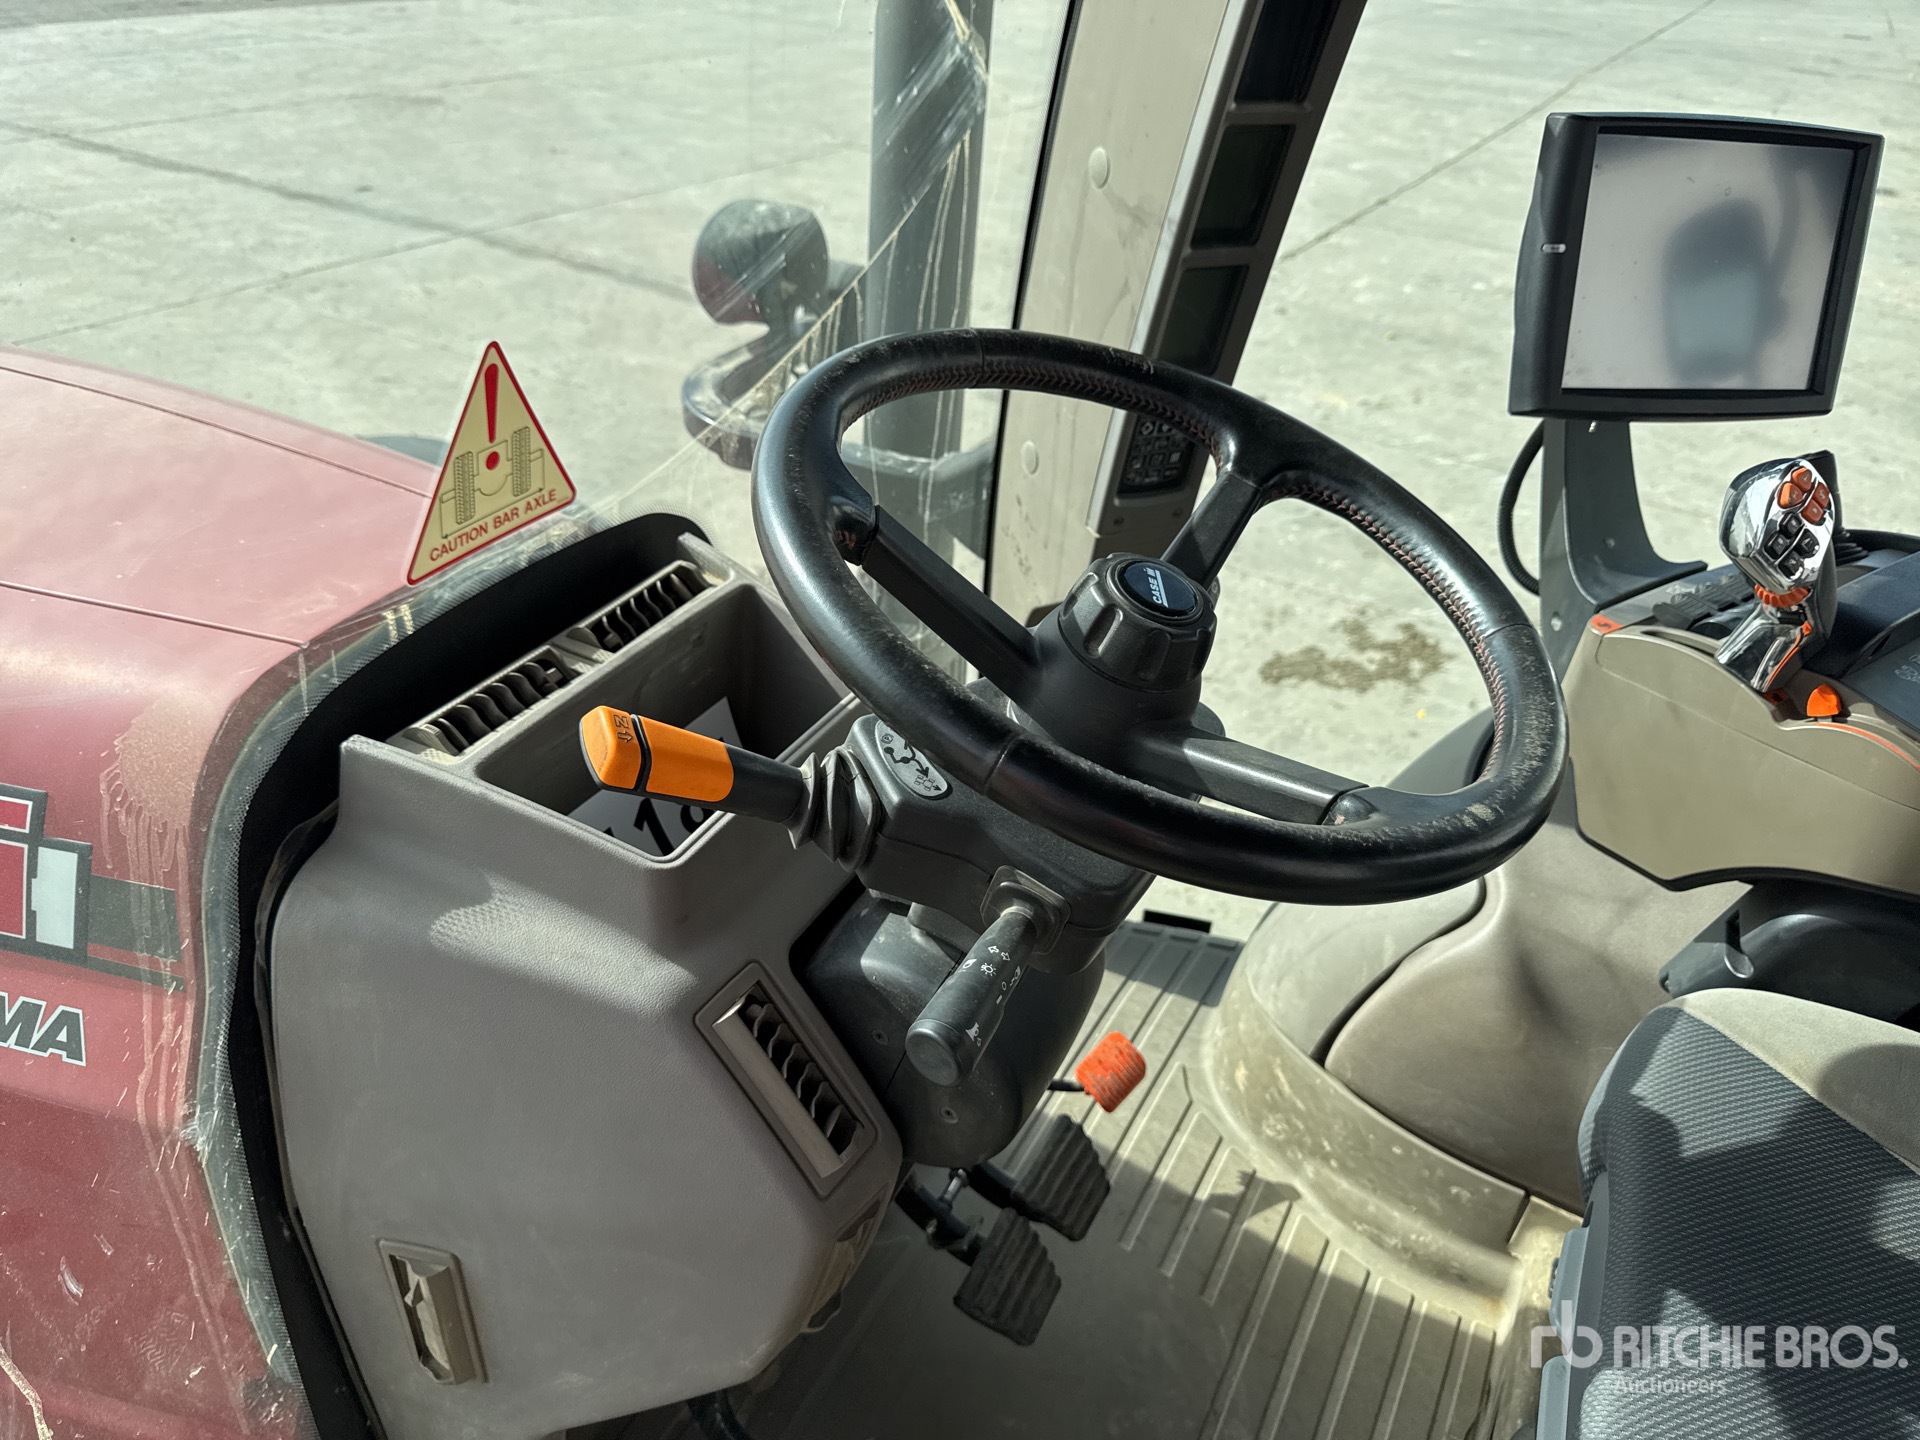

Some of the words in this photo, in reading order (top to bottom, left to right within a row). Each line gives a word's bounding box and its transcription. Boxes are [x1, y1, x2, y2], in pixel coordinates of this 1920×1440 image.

[429, 522, 489, 562] CAUTION
[493, 507, 520, 529] BAR
[524, 488, 557, 514] AXLE
[1148, 577, 1162, 604] CASE
